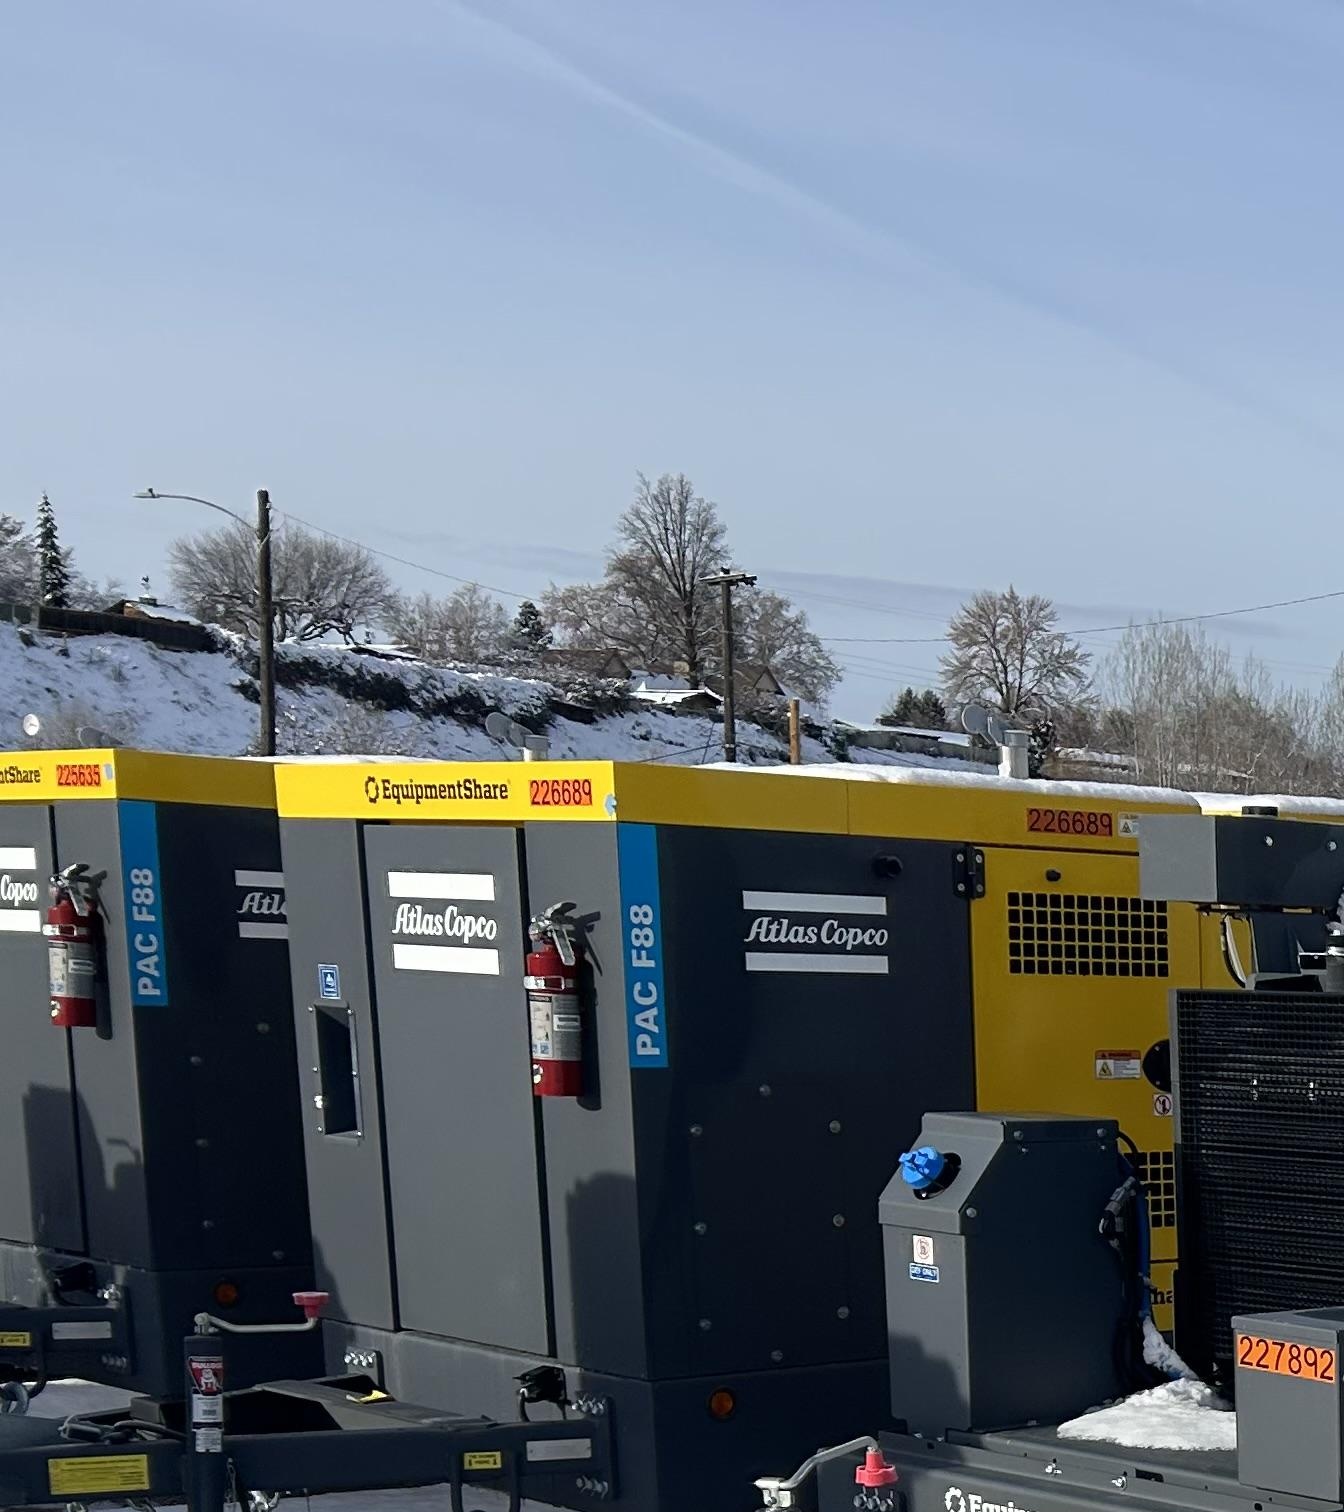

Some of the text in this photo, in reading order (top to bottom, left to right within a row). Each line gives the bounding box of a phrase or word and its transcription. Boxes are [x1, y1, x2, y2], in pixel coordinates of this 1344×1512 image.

[381, 778, 509, 805] EquipmentShare
[530, 779, 593, 806] 226689
[1028, 808, 1113, 837] 226689
[0, 873, 38, 907] Copco
[130, 867, 161, 997] PAC F88
[391, 903, 498, 944] Atlas Copco
[743, 916, 889, 951] Atlas Copco
[629, 903, 661, 1056] PAC F88
[1239, 1335, 1334, 1381] 227892
